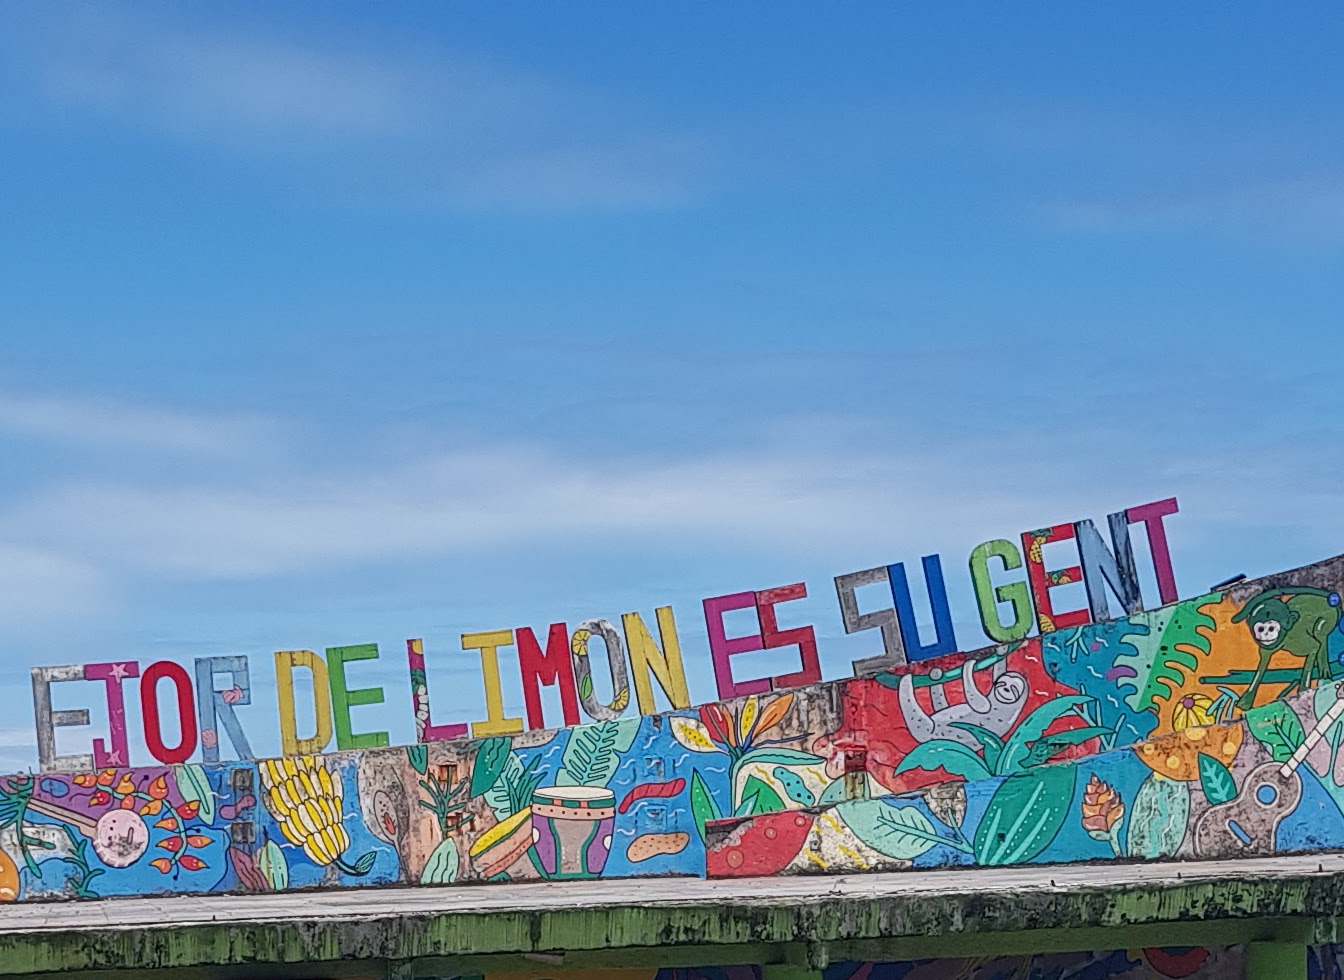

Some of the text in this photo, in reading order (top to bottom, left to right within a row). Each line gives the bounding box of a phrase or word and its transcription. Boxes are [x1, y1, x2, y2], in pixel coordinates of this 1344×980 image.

[31, 655, 255, 774] EJOR
[274, 642, 391, 756] DE
[406, 605, 691, 743] LIMON
[702, 582, 822, 700] ES
[834, 553, 957, 677] SU
[969, 497, 1180, 643] GENT
